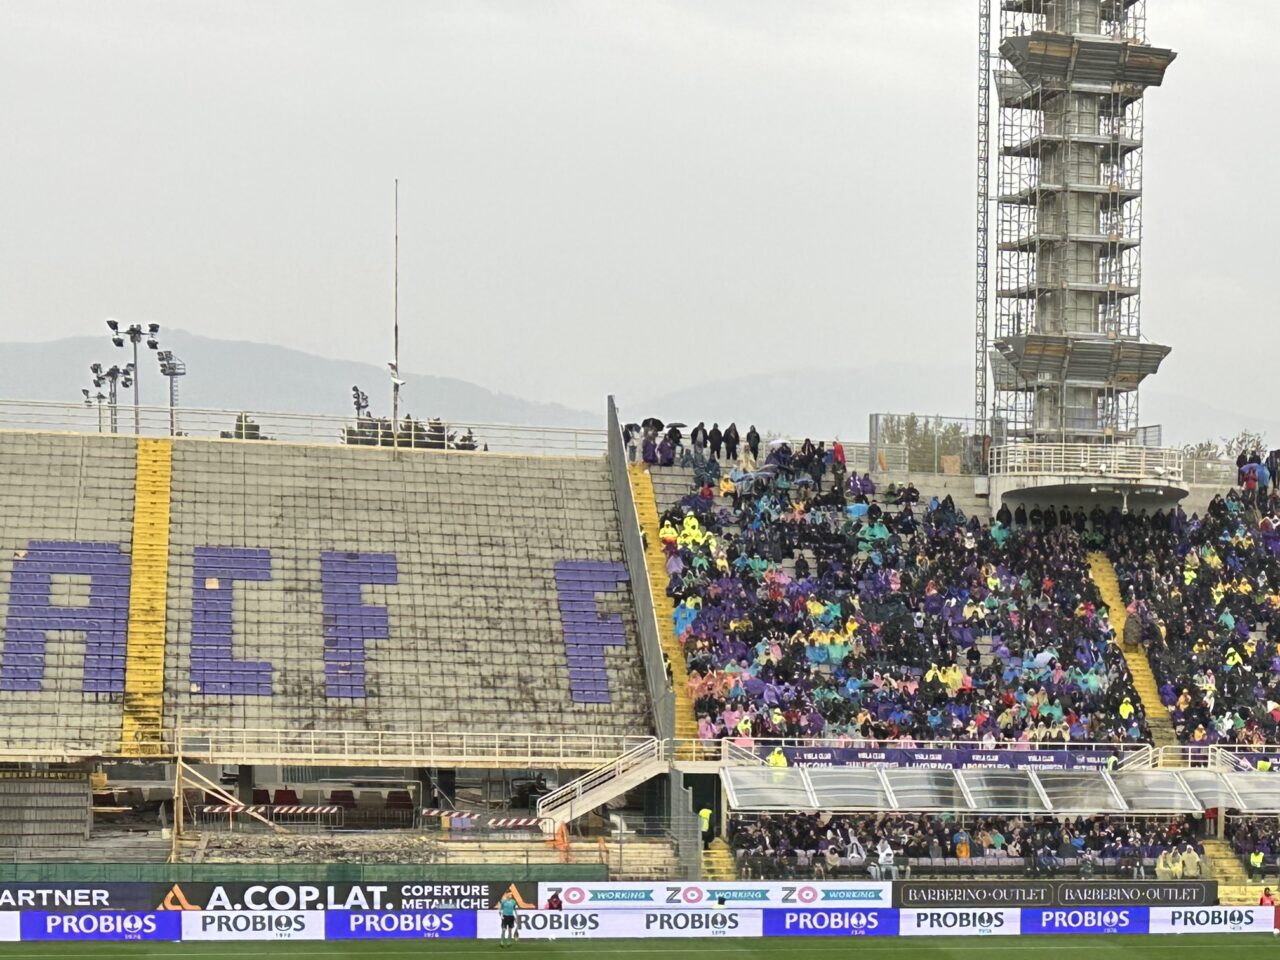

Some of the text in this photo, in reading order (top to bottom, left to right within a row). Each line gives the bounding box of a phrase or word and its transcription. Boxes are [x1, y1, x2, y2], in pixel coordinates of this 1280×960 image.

[0, 888, 110, 907] ARTNER
[206, 885, 394, 911] A.COP.LAT.
[401, 885, 489, 897] COPERTURE
[596, 890, 646, 900] WORKING
[828, 891, 876, 900] WORKING
[401, 898, 489, 910] METALLICHE
[47, 914, 157, 934] PROBIOS
[202, 914, 306, 932] PROBIOS
[350, 913, 454, 932] PROBIOS
[517, 913, 600, 931] ROBIOS
[646, 913, 739, 931] PROBIOS
[785, 912, 879, 930] PROBIOS
[916, 911, 1004, 929] PROBIOS
[1041, 910, 1130, 927] PROBIOS
[1171, 909, 1254, 926] PROBIOS
